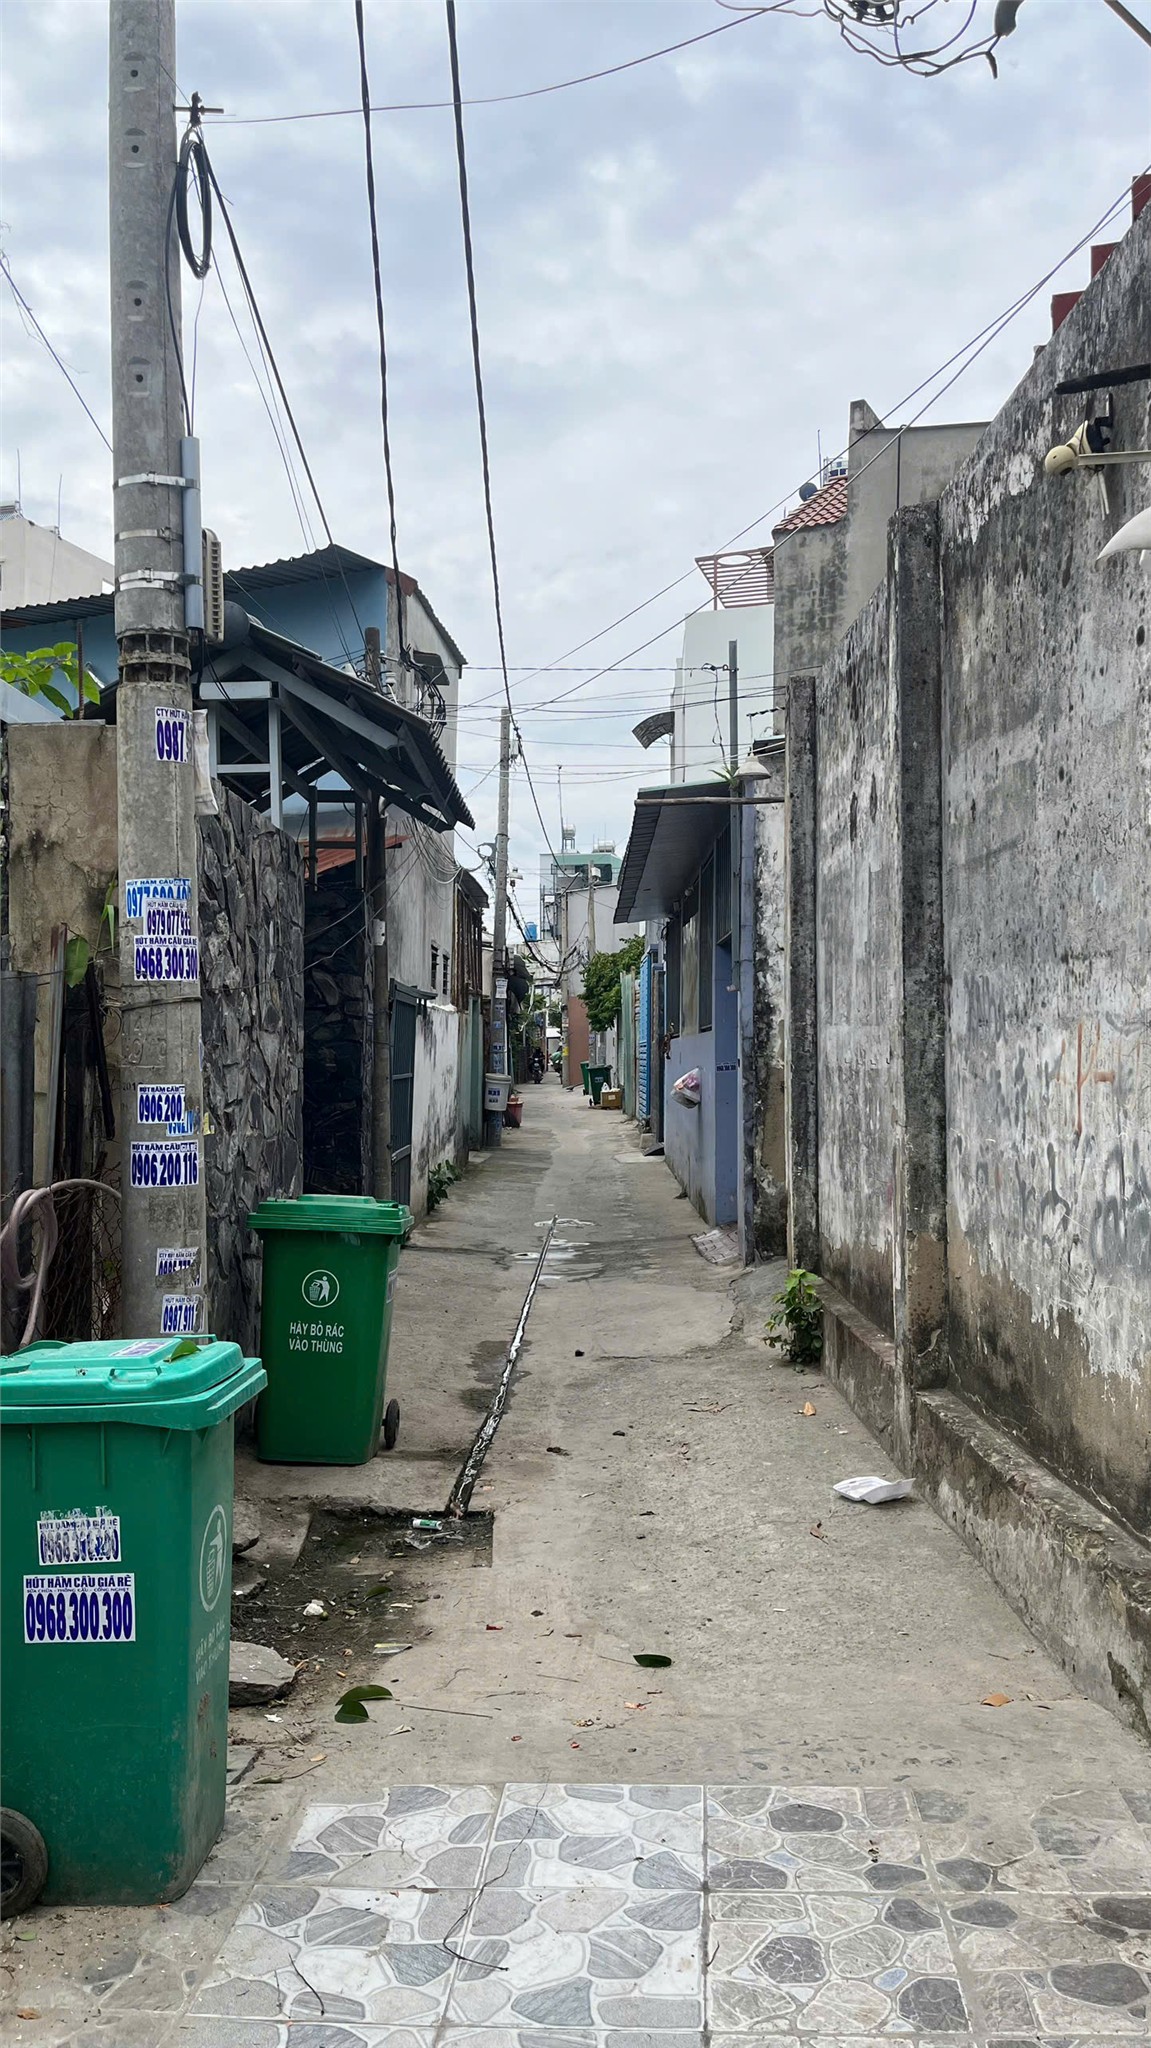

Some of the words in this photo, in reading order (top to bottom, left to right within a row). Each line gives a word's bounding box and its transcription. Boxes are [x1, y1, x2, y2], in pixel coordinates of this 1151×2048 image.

[132, 1152, 198, 1186] 0906.200.116
[325, 1322, 345, 1338] RÁC
[289, 1336, 309, 1351] VÀO
[311, 1338, 343, 1353] THÙNG
[26, 1576, 45, 1589] HÚT
[47, 1575, 72, 1588] HẦM
[74, 1575, 96, 1588] CẦU
[26, 1592, 132, 1641] 0968.300.300
